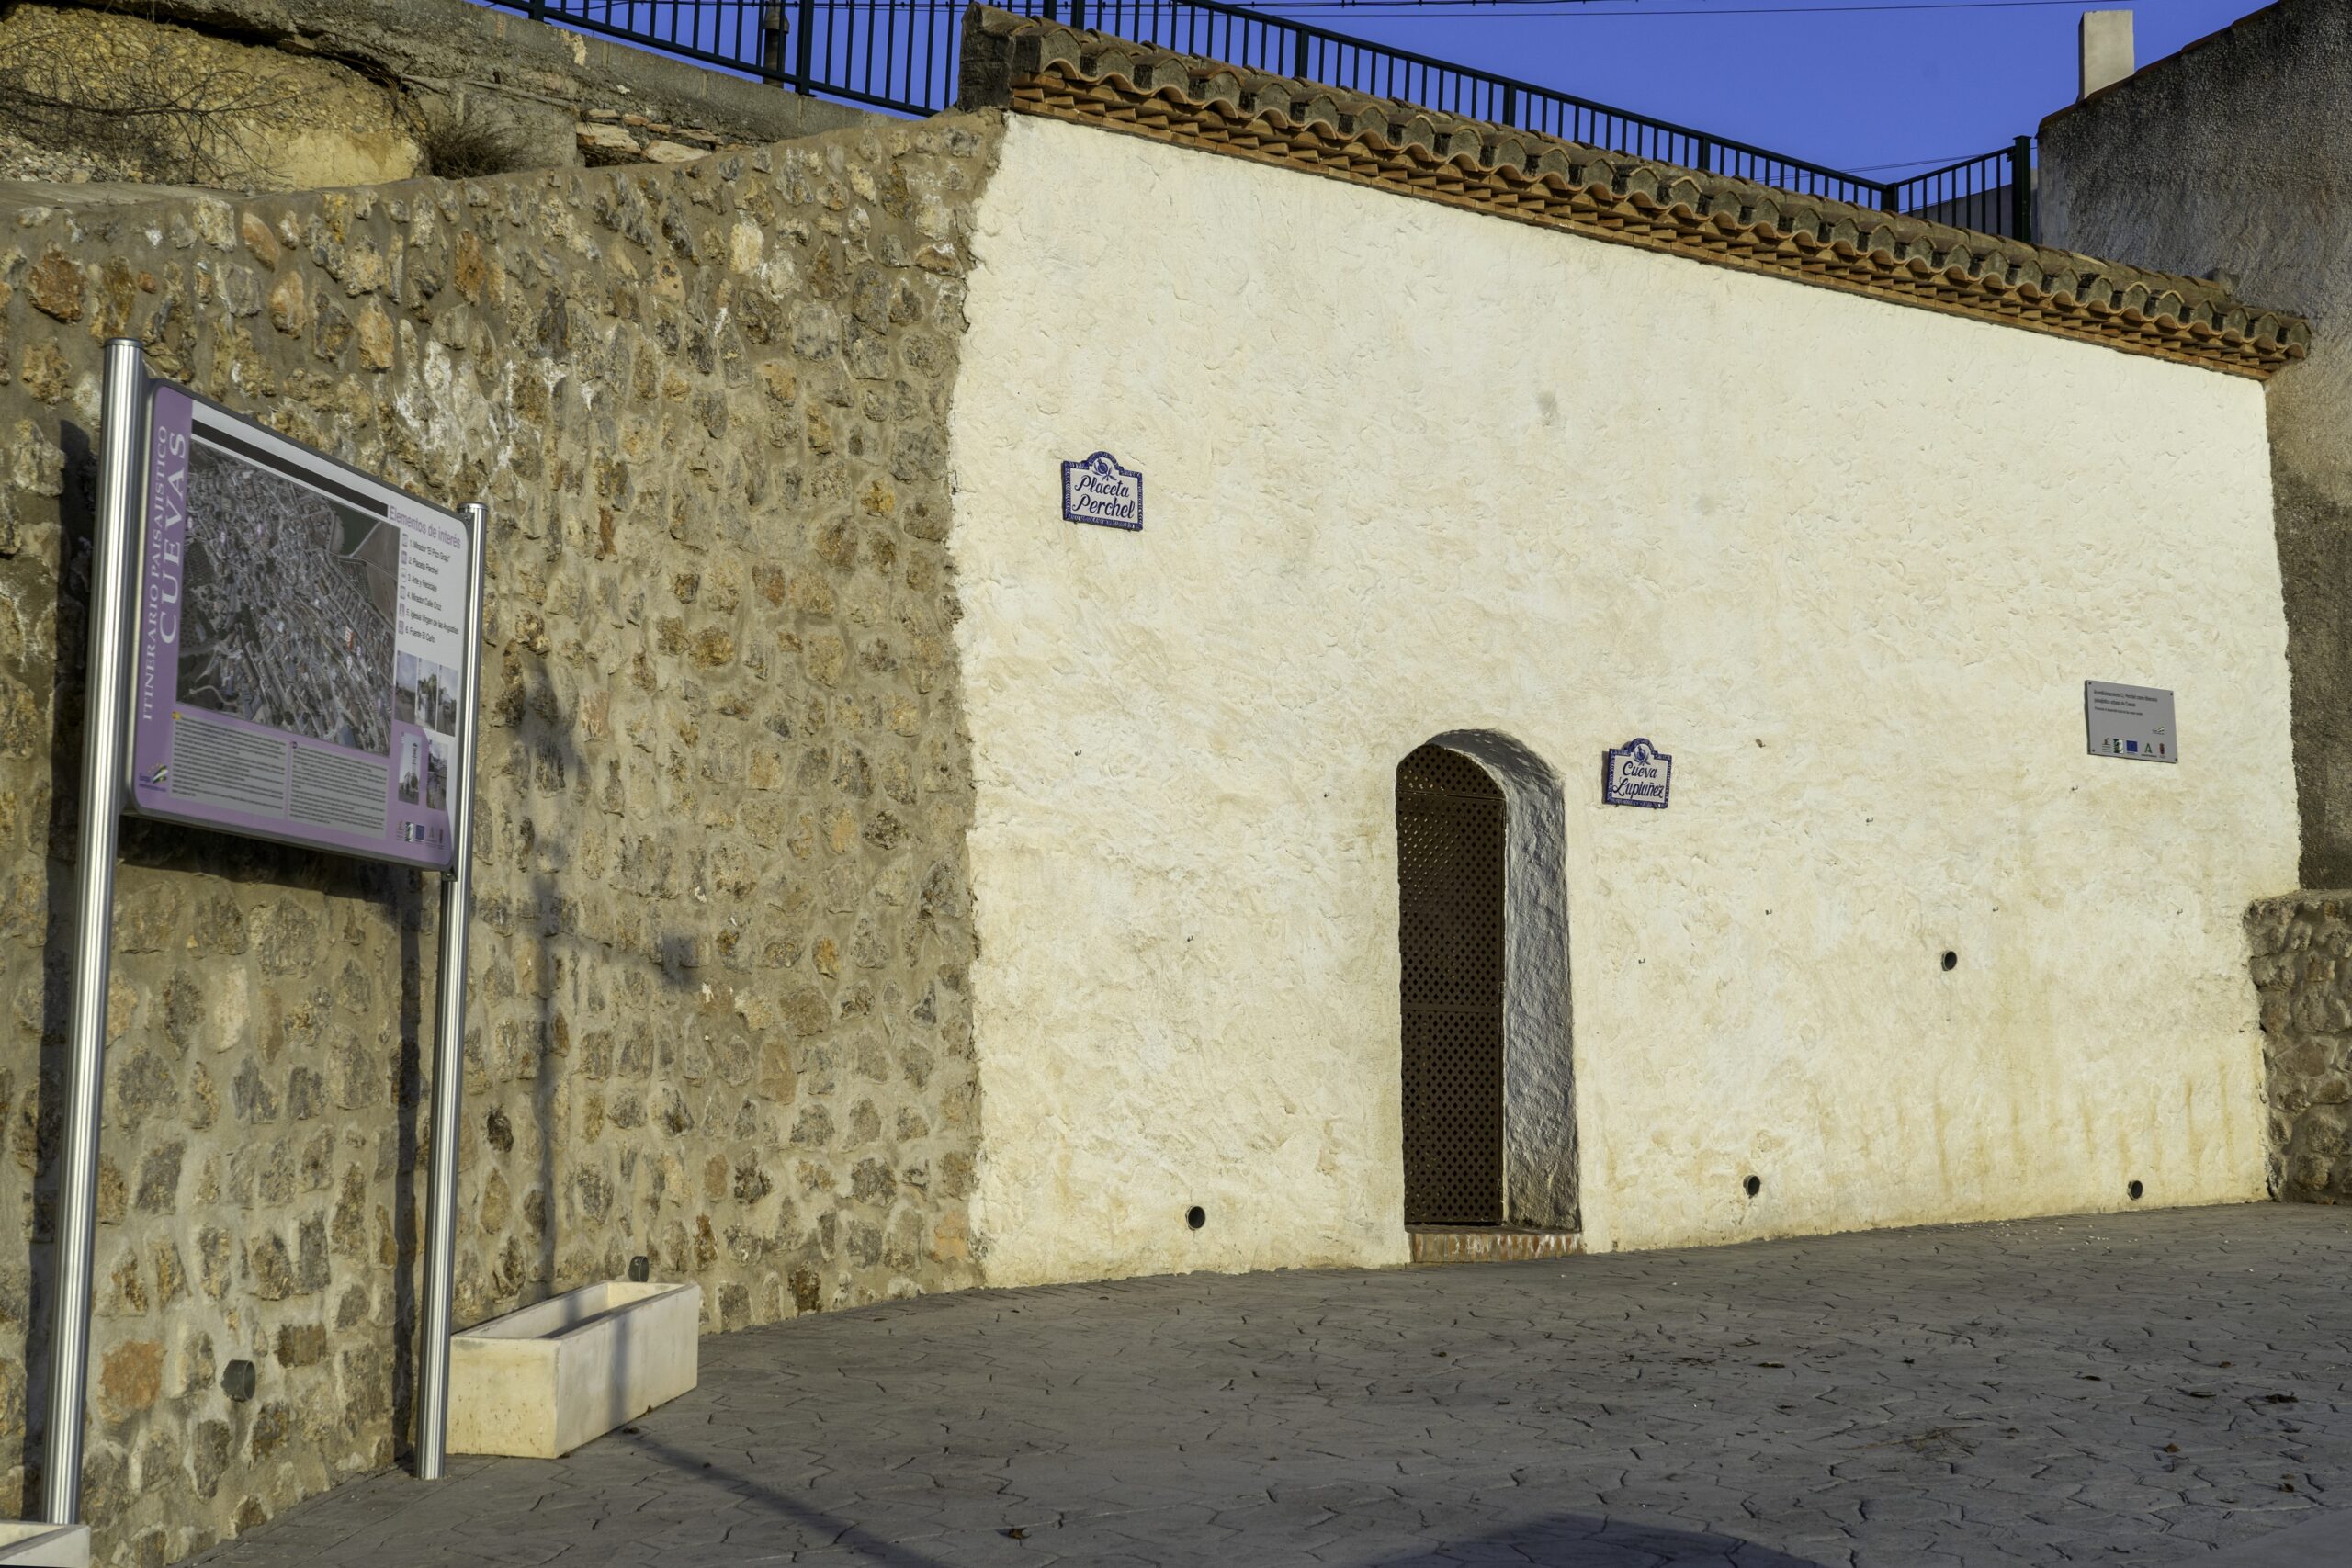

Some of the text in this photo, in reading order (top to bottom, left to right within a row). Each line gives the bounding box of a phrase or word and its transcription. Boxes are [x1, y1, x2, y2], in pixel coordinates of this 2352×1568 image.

[1074, 474, 1129, 498] Placeta
[1072, 493, 1136, 519] Perchel
[159, 432, 187, 644] CUEVAS
[389, 505, 461, 548] Elementos de interés
[143, 425, 168, 720] ITINERARIO PAISAJISTICO
[1622, 761, 1657, 779] Cueva
